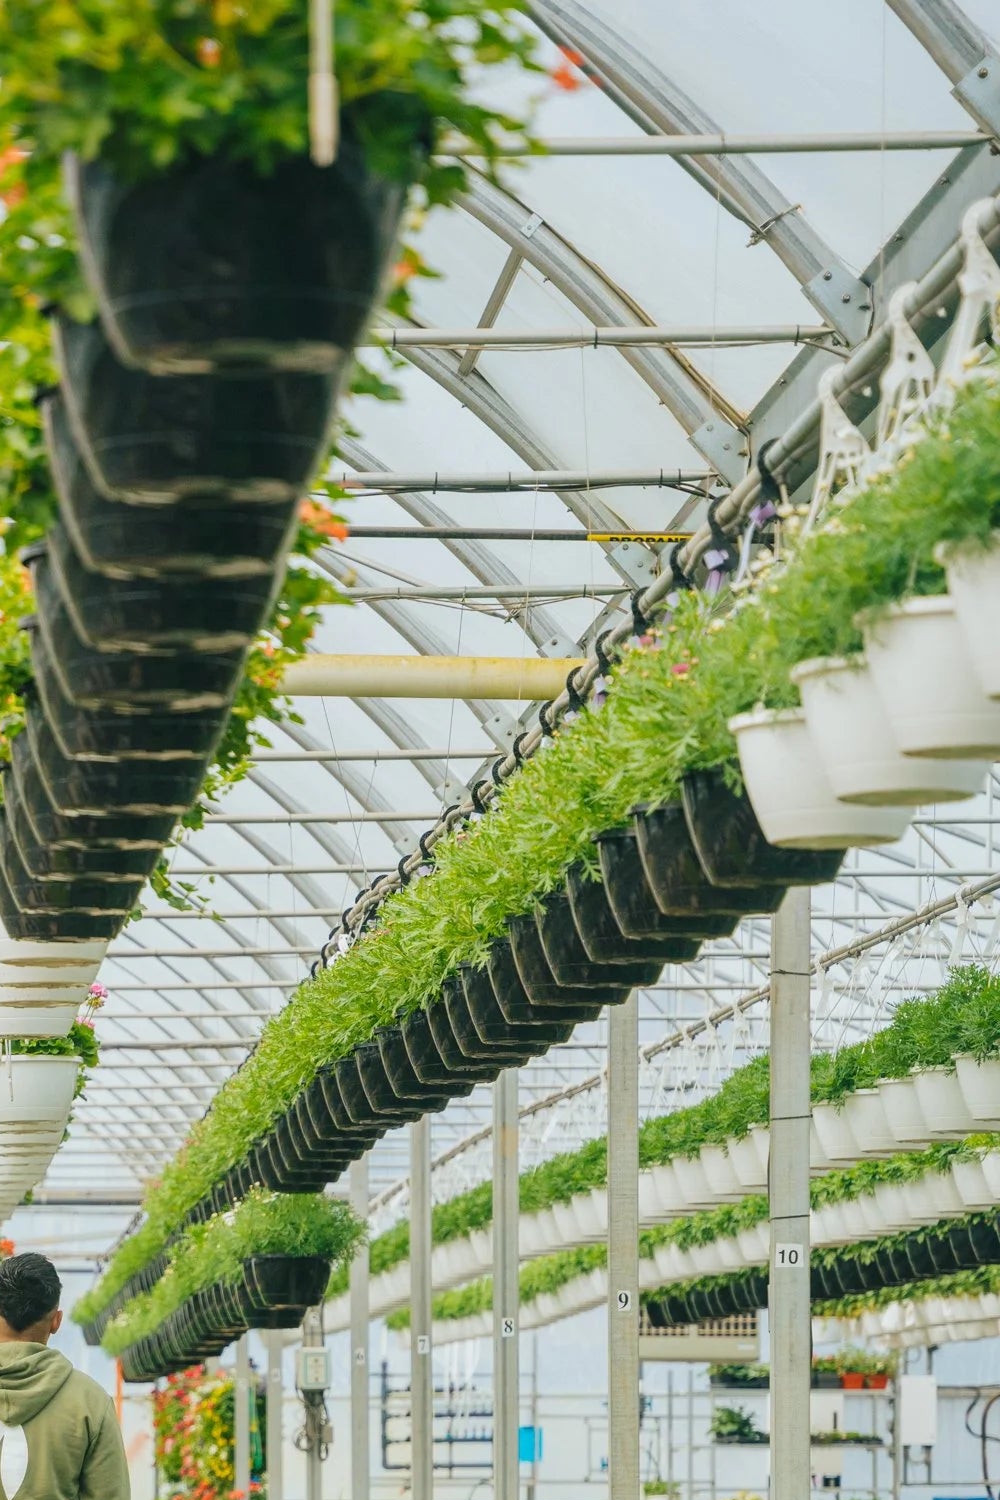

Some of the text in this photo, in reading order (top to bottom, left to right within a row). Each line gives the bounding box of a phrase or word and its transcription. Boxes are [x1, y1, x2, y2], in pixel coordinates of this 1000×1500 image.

[779, 1249, 799, 1264] 10
[618, 1292, 629, 1309] 9
[504, 1319, 513, 1334] 8
[419, 1338, 426, 1351] 7
